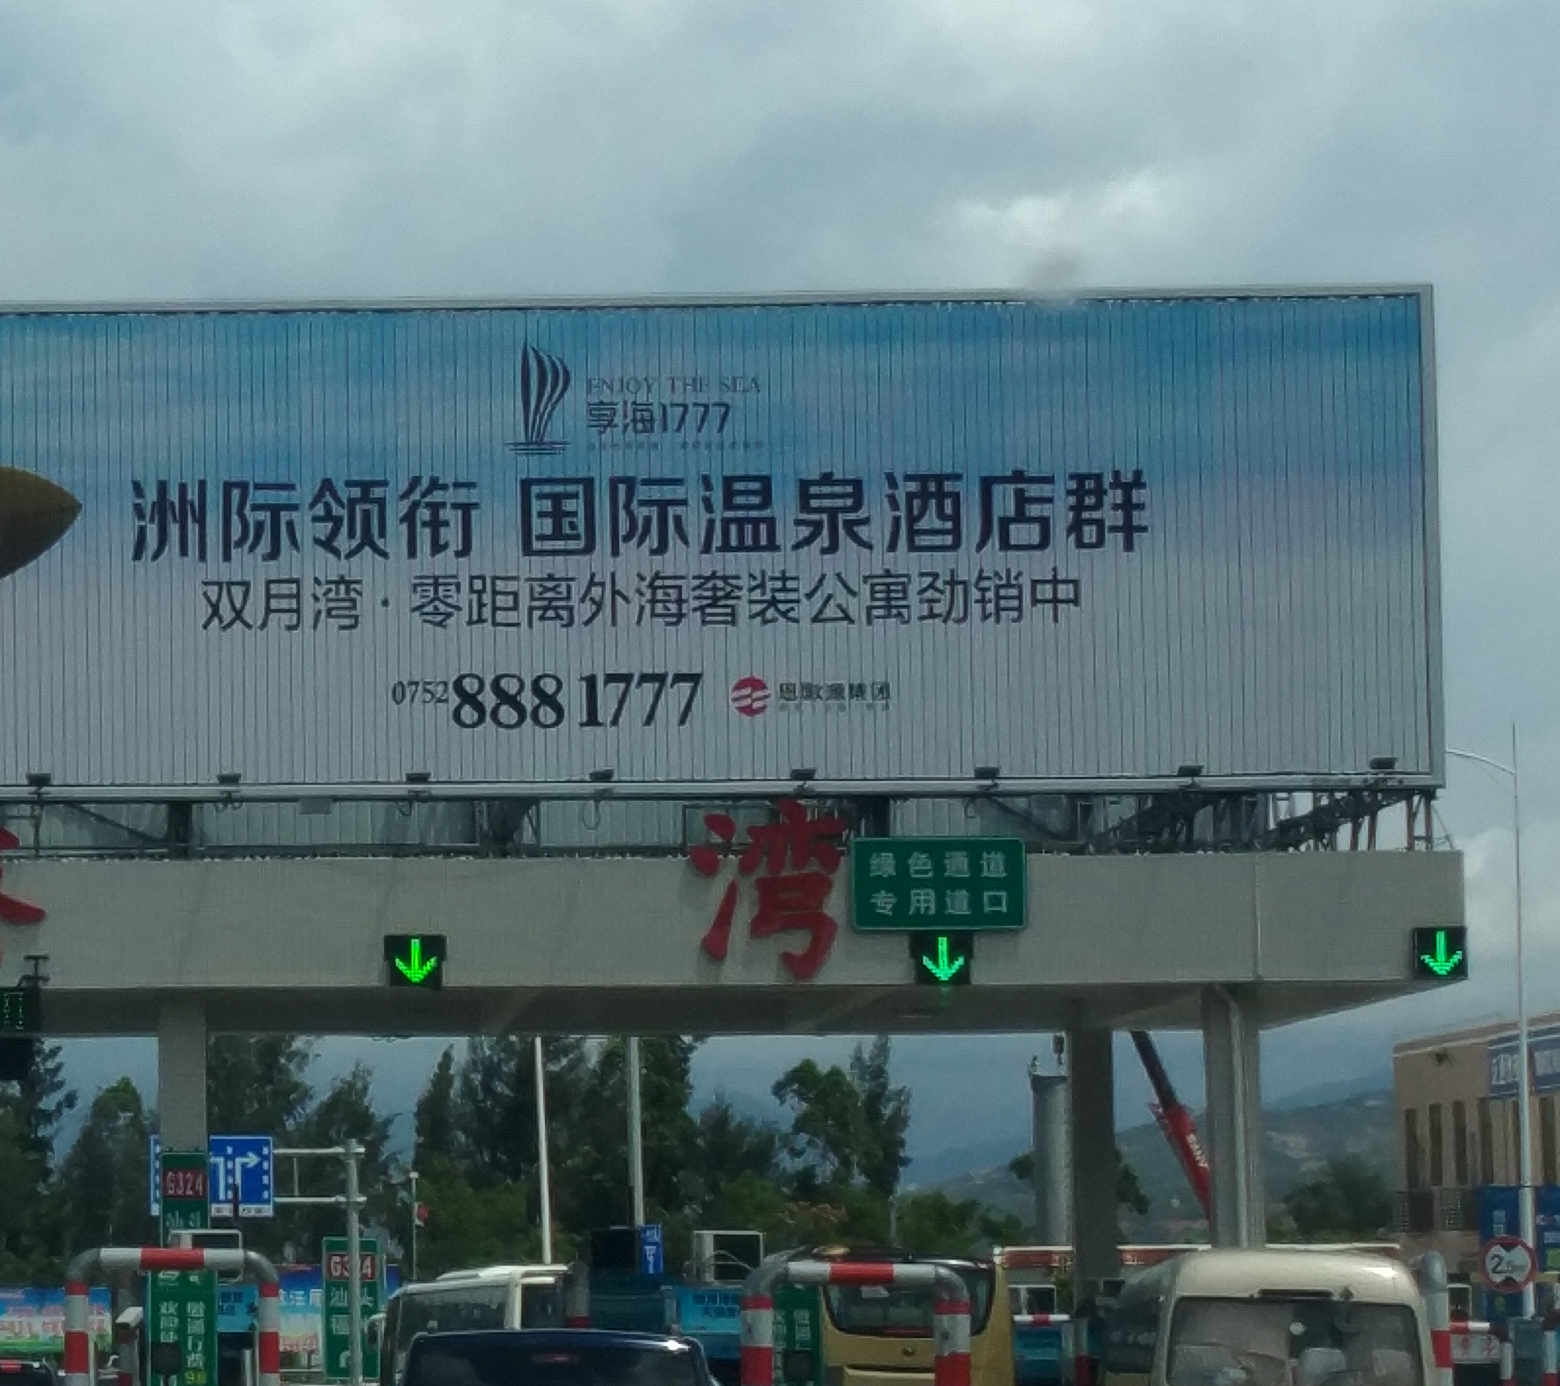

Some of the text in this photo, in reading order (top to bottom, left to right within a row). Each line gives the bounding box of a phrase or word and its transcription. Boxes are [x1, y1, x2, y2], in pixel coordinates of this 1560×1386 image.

[720, 376, 761, 394] SEA
[587, 398, 732, 434] 享海1777
[131, 469, 1150, 563] 洲际领衔 国际温泉酒店群
[392, 680, 449, 705] 0752
[869, 851, 1008, 878] 绿色通道
[869, 888, 1008, 916] 专用道口
[166, 1171, 203, 1197] G324
[329, 1254, 373, 1279] G34
